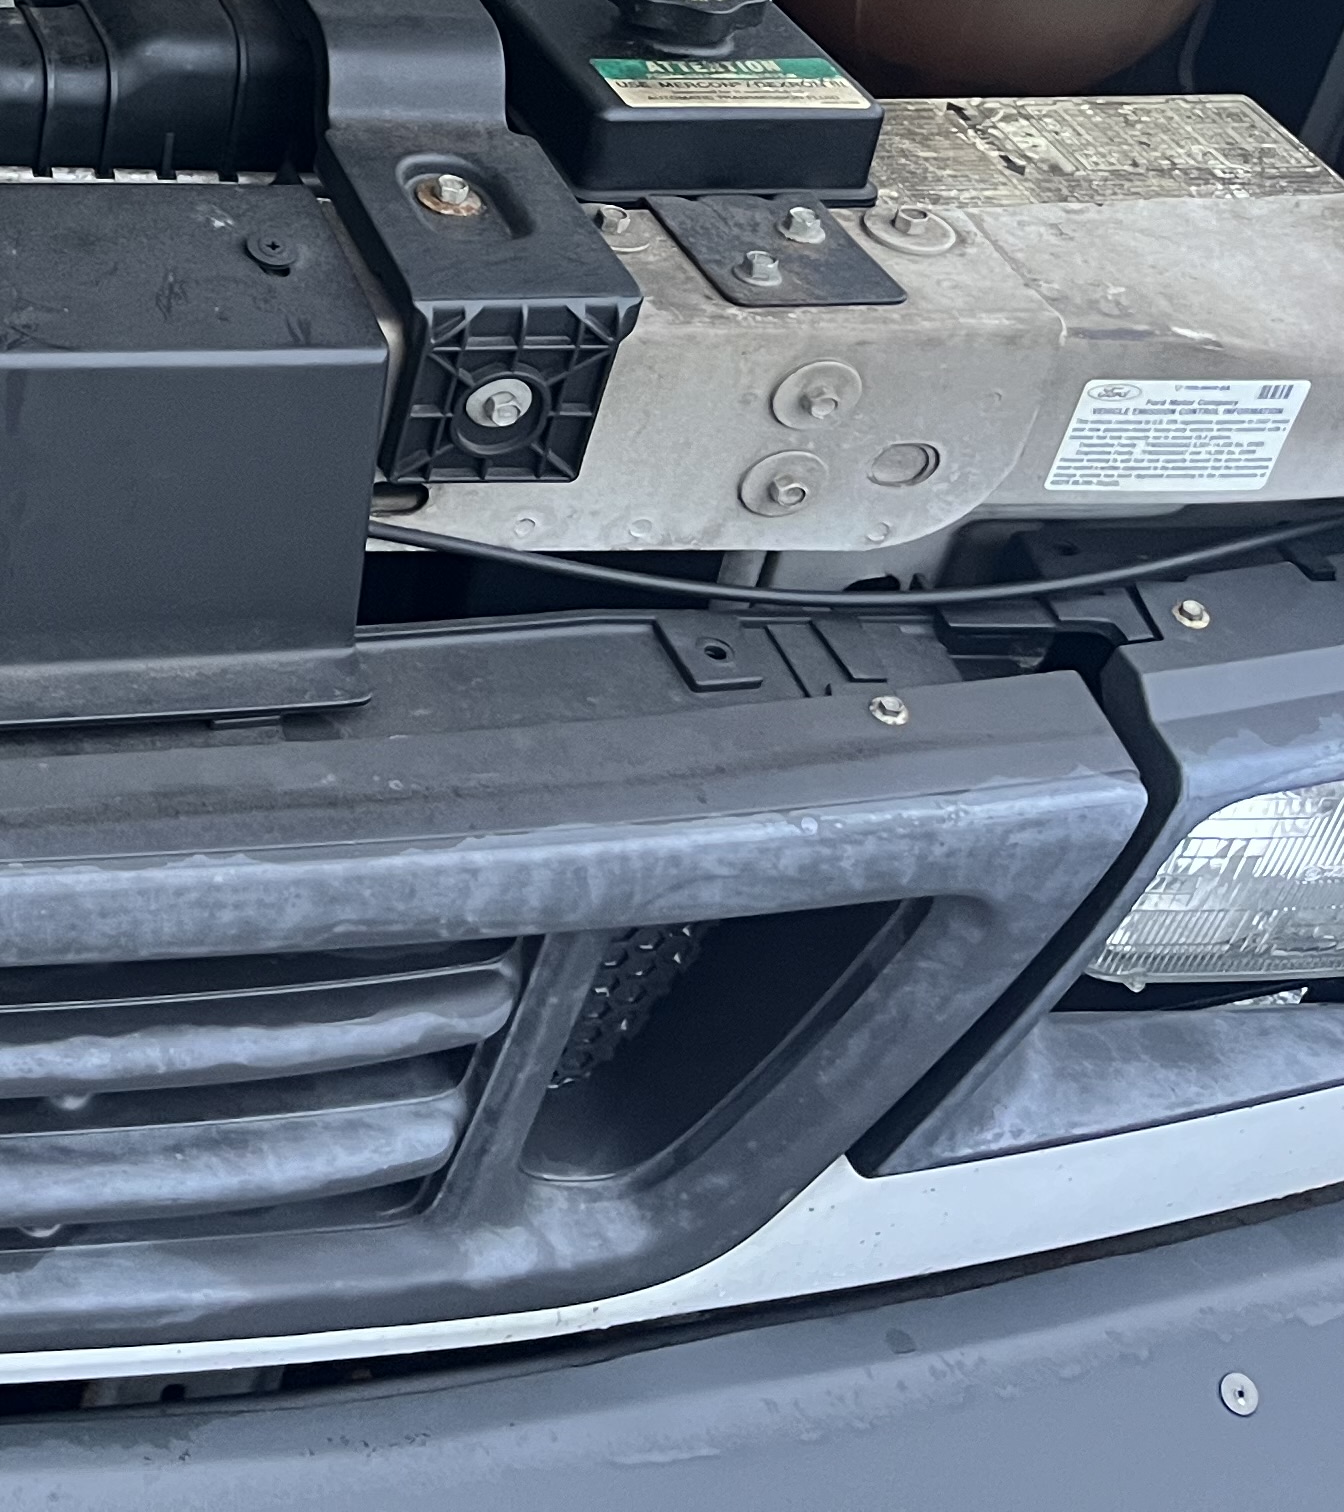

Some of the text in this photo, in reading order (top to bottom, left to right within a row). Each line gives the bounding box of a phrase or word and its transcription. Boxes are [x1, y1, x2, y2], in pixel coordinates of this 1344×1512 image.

[615, 81, 652, 89] USE
[1145, 398, 1239, 407] Ford Motor Company
